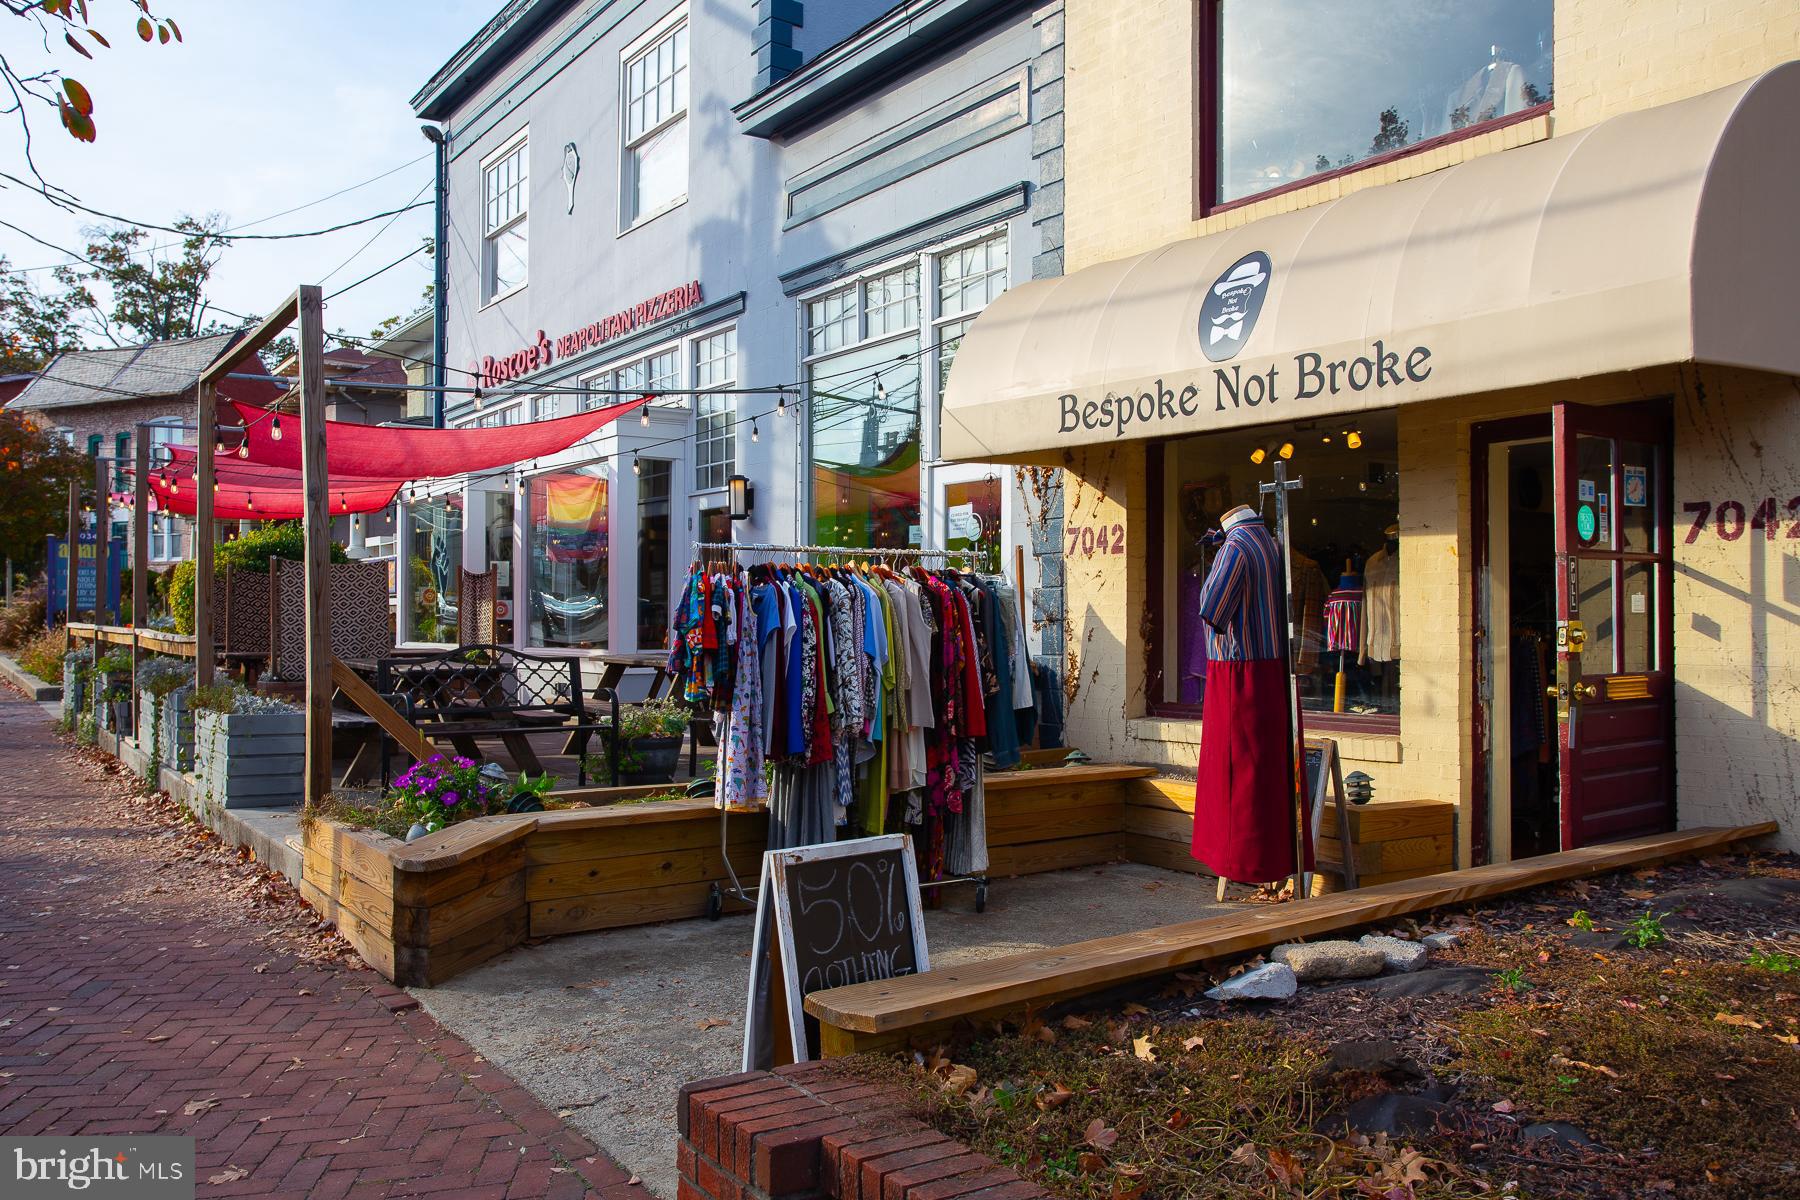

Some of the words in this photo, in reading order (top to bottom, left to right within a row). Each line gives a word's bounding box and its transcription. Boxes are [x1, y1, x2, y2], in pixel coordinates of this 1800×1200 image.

[1221, 287, 1248, 300] Bespoke
[1221, 305, 1240, 314] Broke
[1227, 297, 1239, 305] Not
[481, 329, 553, 388] Roscoe's
[557, 307, 634, 358] NEAPOLITAN
[634, 280, 704, 326] PIZZERIA
[1058, 379, 1199, 437] Bespoke
[1213, 364, 1279, 412] Not
[1294, 340, 1433, 400] Broke
[1067, 523, 1125, 556] 7042
[1569, 561, 1577, 607] PULL
[798, 859, 905, 954] 50%
